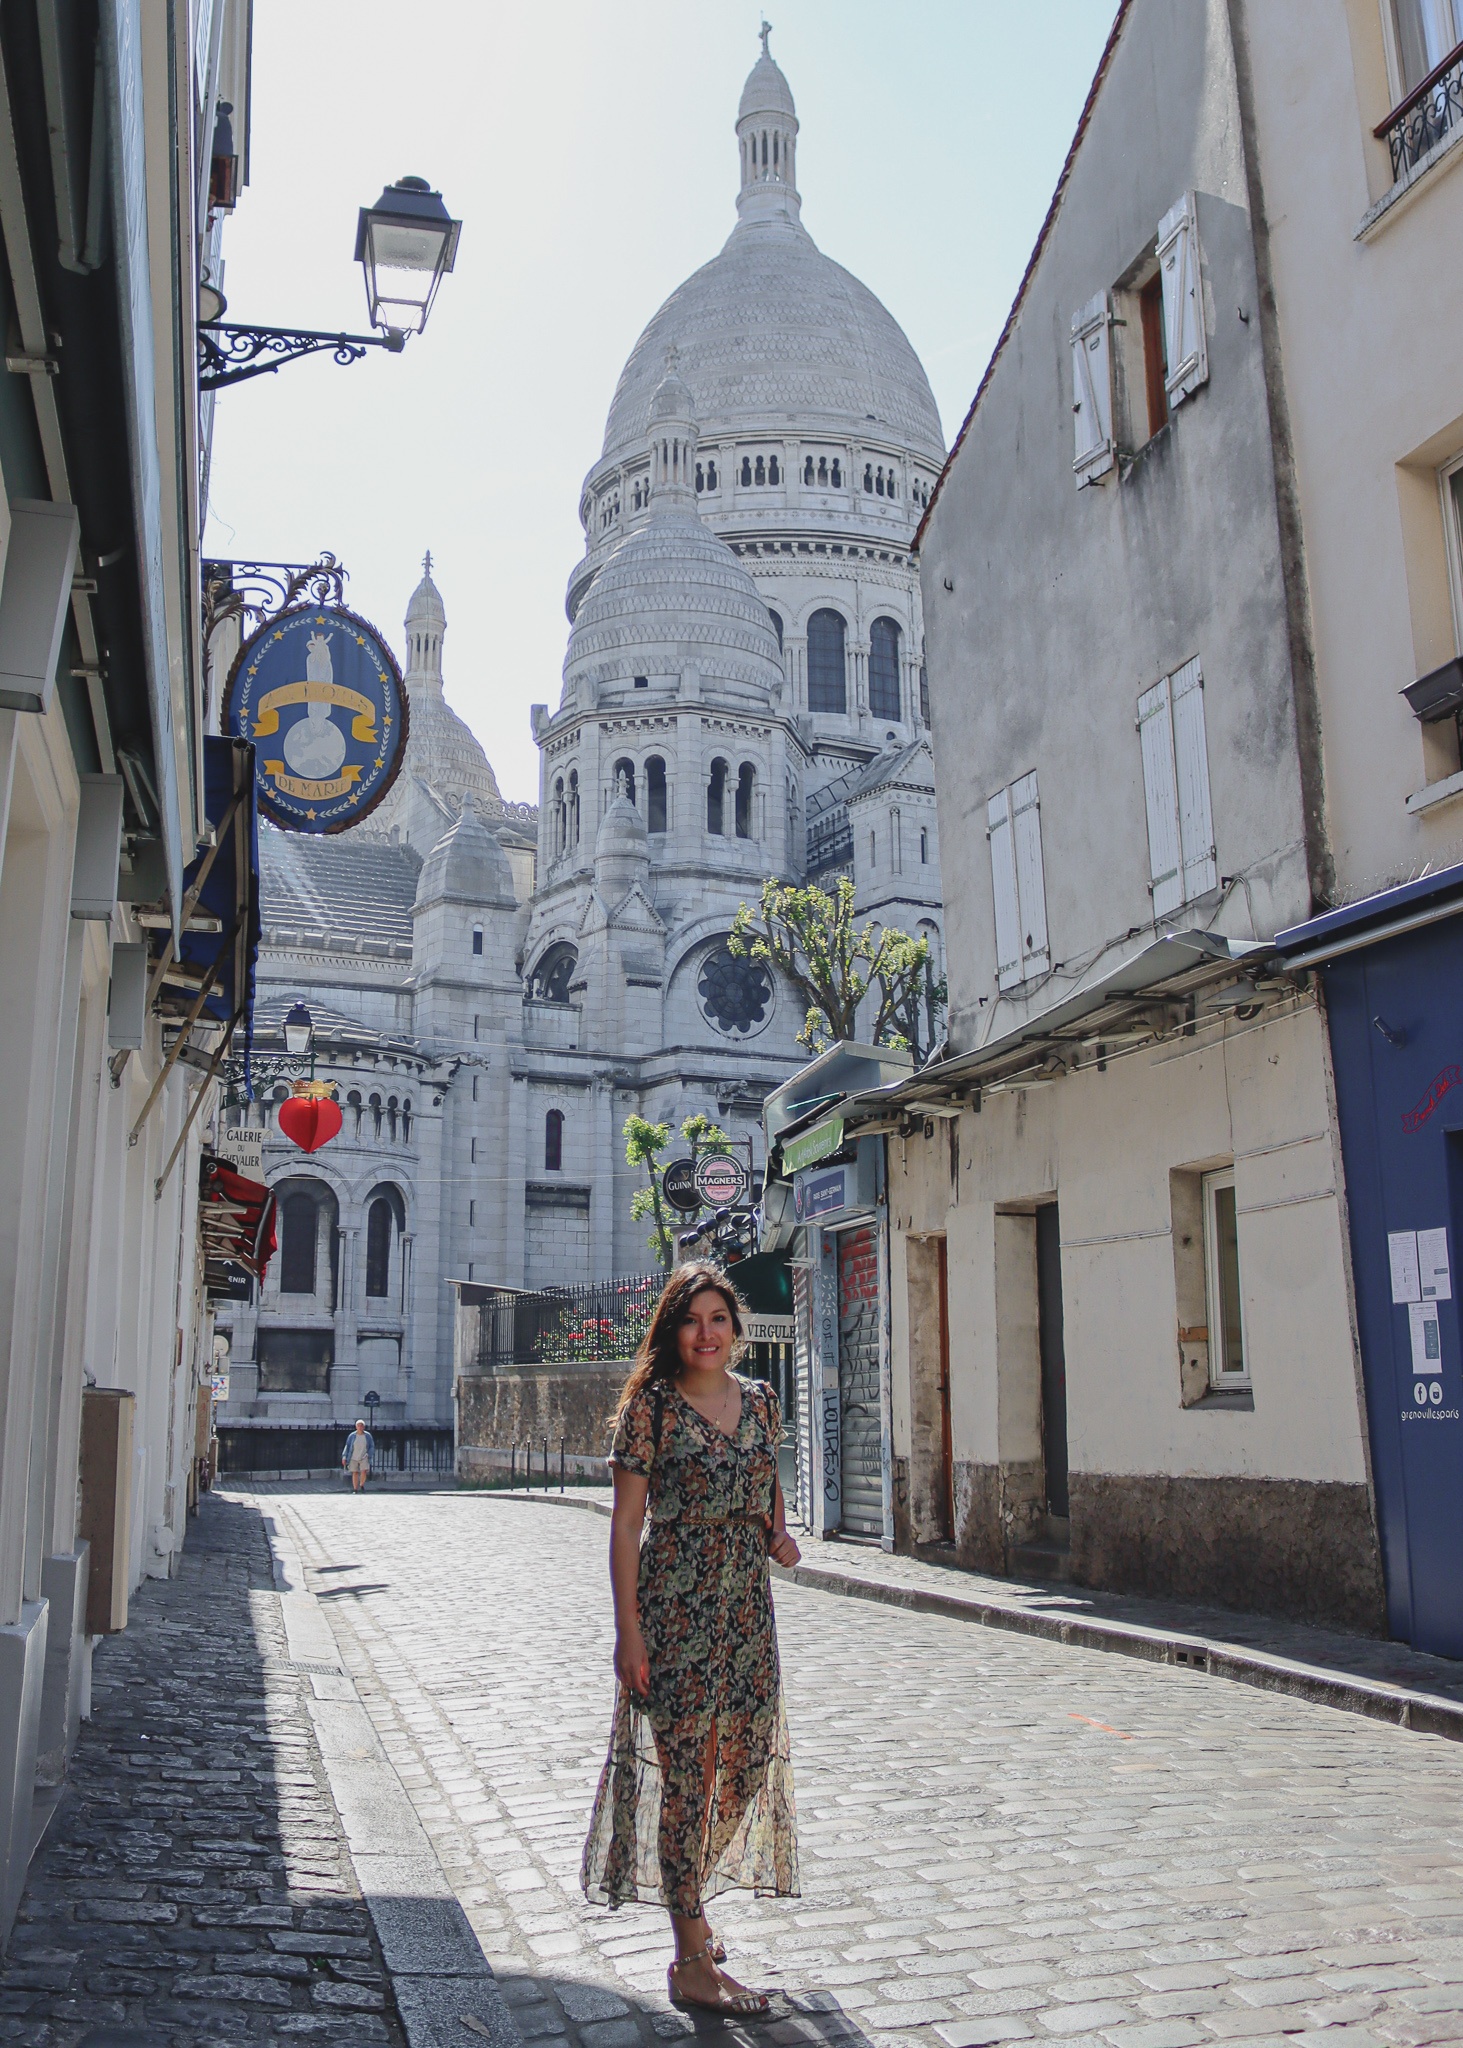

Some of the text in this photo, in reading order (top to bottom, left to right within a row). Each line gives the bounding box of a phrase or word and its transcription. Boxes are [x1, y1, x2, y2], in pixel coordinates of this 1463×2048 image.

[278, 776, 295, 793] DE
[226, 1129, 262, 1143] GALERIE
[237, 1144, 246, 1152] DU
[697, 1176, 744, 1186] MAGNERS
